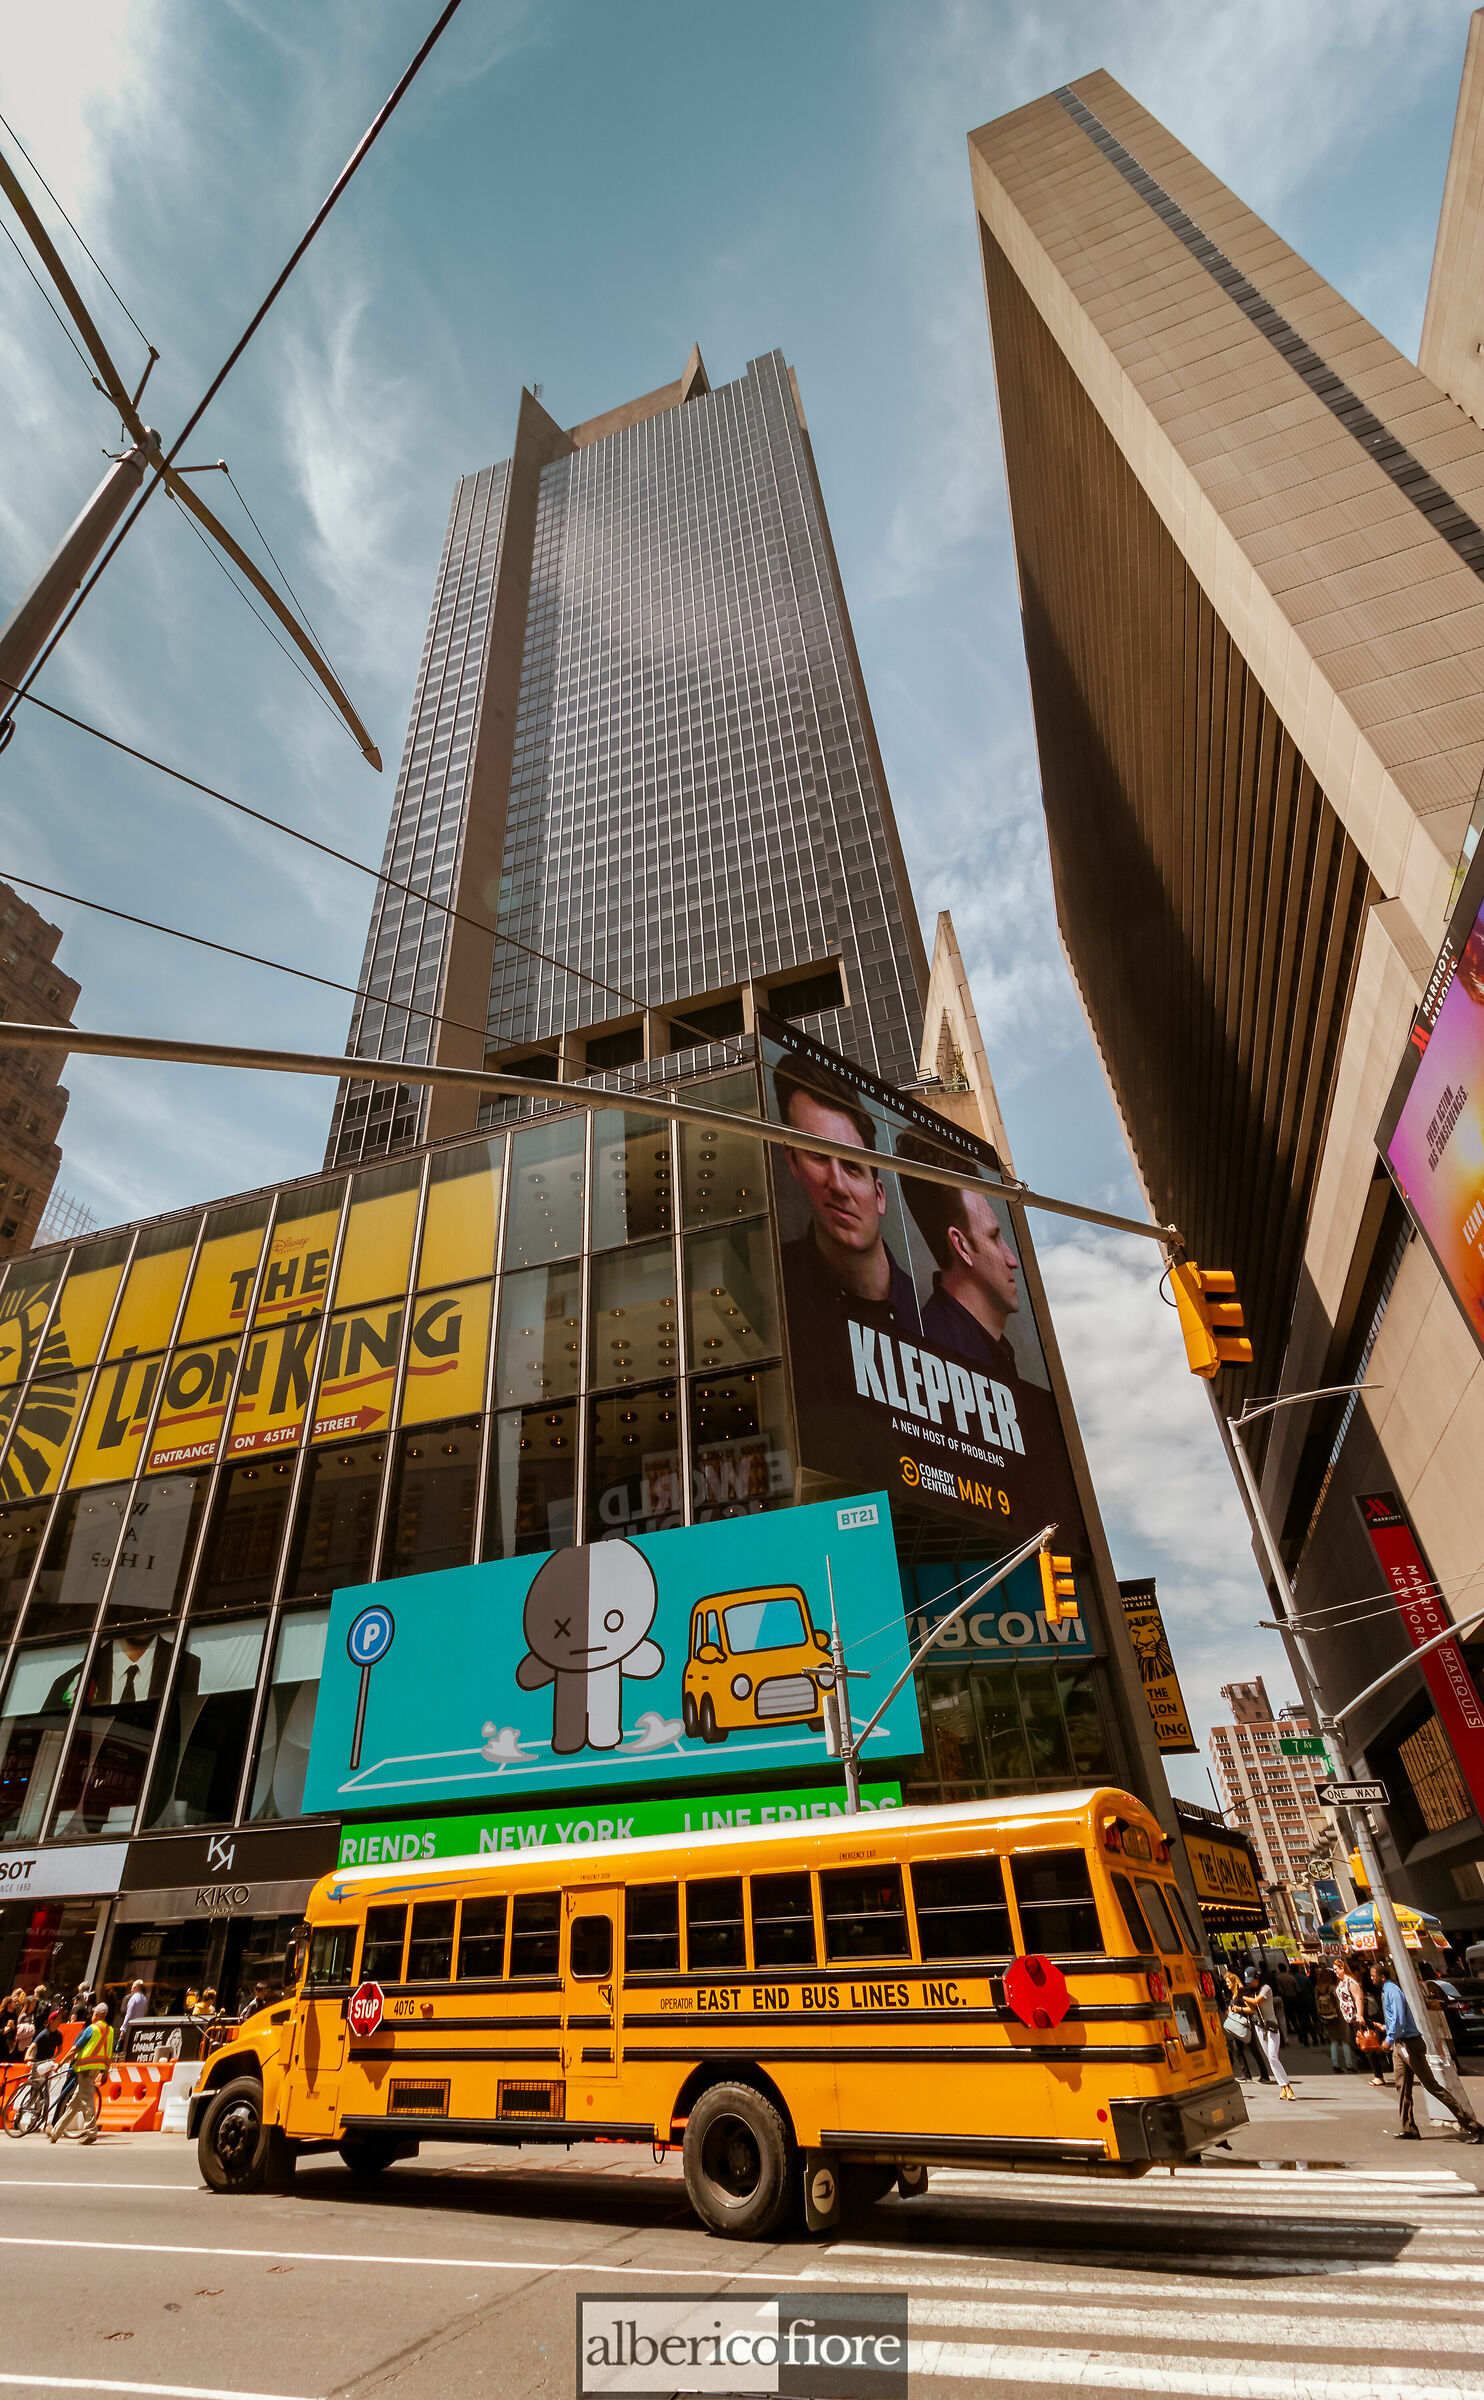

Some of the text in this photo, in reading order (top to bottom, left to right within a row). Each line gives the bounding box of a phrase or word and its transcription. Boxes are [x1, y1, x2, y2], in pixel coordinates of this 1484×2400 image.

[1422, 937, 1453, 1017] MARRIOTT
[782, 1034, 979, 1155] AN ARRESTING NEW DOCUSERIES
[1425, 1084, 1454, 1147] EVERY ACTION
[229, 1248, 330, 1311] THE
[96, 1298, 462, 1450] LION KING
[848, 1319, 1026, 1455] KLEPPER
[153, 1415, 358, 1465] ENTRANCE ON 45TH STREET
[891, 1417, 1005, 1468] A NEW HOST OF PROBLEMS
[919, 1463, 954, 1485] COMEDY
[921, 1477, 958, 1499] CENTRAL
[958, 1476, 1010, 1516] MAY 9
[841, 1509, 875, 1526] BT21
[1390, 1567, 1430, 1646] NEW YORK
[363, 1623, 380, 1651] P
[1147, 1687, 1168, 1699] THE
[1441, 1651, 1481, 1726] MARQUIS
[1292, 1740, 1299, 1753] 7
[1327, 1788, 1377, 1799] ONE WAY
[341, 1832, 437, 1864] RIENDS
[479, 1824, 547, 1854] NEW
[555, 1817, 634, 1844] YORK
[1198, 1844, 1253, 1897] THE LION KING
[195, 1885, 250, 1907] KIKO
[354, 1998, 414, 2019] STOP 407G
[660, 1982, 967, 2011] OPERATOR EAST END BUS LINES INC.
